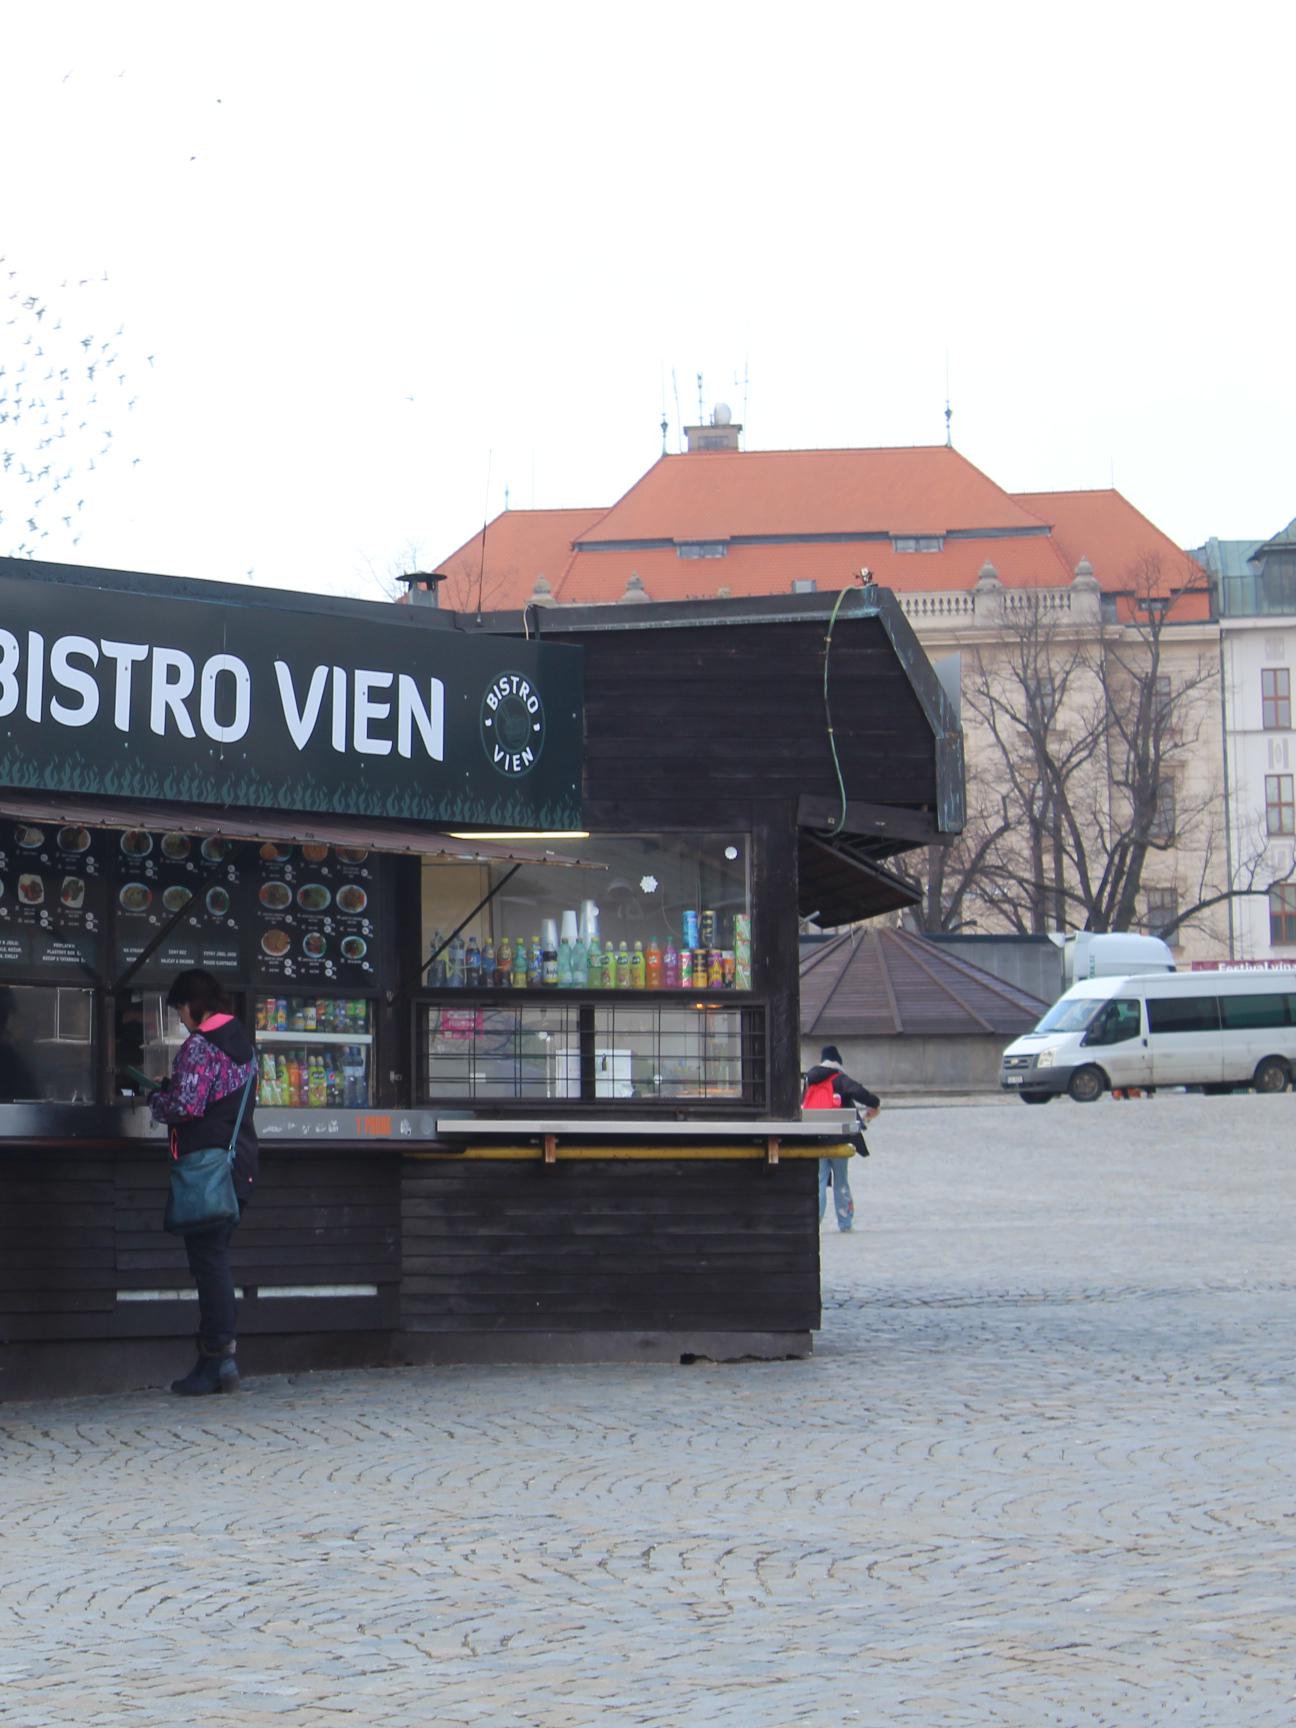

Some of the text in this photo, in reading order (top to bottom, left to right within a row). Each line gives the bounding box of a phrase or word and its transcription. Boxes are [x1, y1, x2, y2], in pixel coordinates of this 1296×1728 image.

[274, 660, 444, 762] VIEN
[486, 676, 539, 714] BISTRO
[493, 744, 534, 772] VIEN
